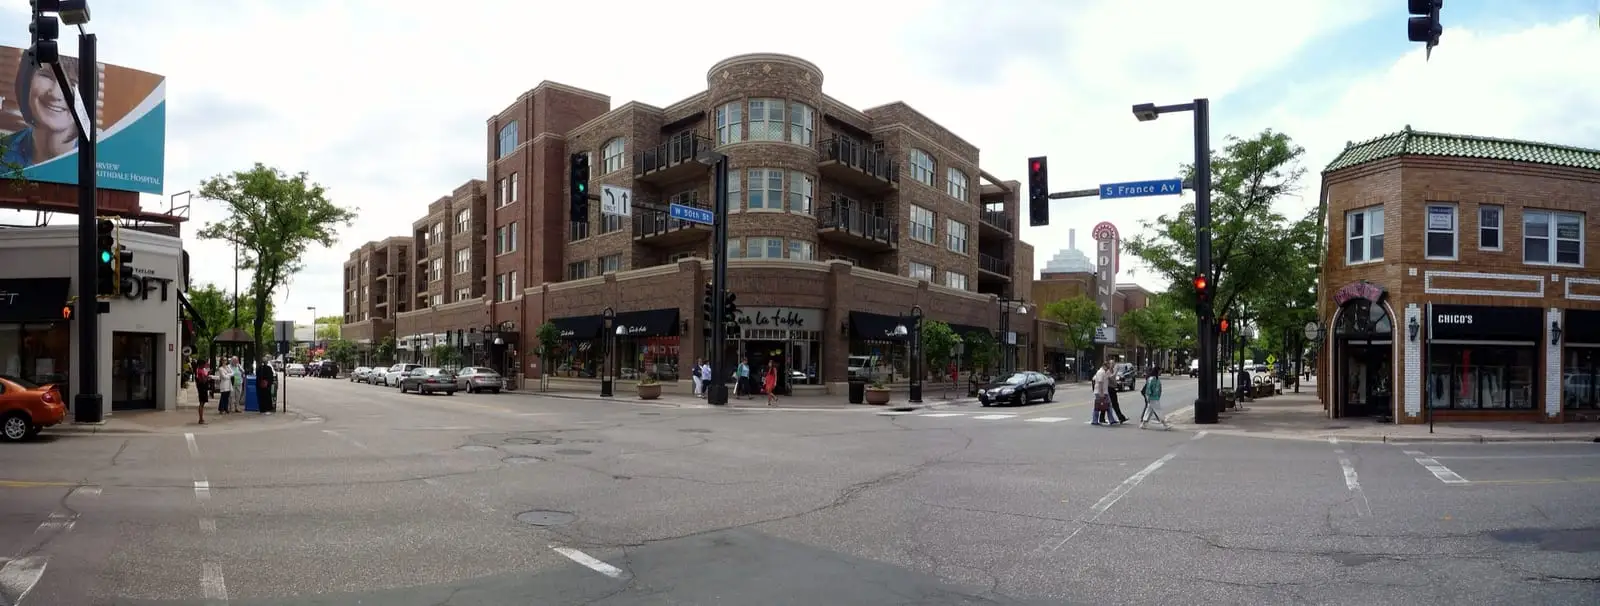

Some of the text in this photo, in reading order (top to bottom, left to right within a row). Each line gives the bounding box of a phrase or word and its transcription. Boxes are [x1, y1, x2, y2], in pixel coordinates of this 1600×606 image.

[96, 169, 129, 180] UTHDALE
[1106, 183, 1175, 196] S France Av
[675, 207, 710, 221] W 50th St
[1098, 241, 1110, 311] EDINA
[122, 275, 174, 302] OFT
[756, 311, 770, 326] la
[771, 308, 804, 327] table
[1438, 314, 1473, 324] CHICO'S
